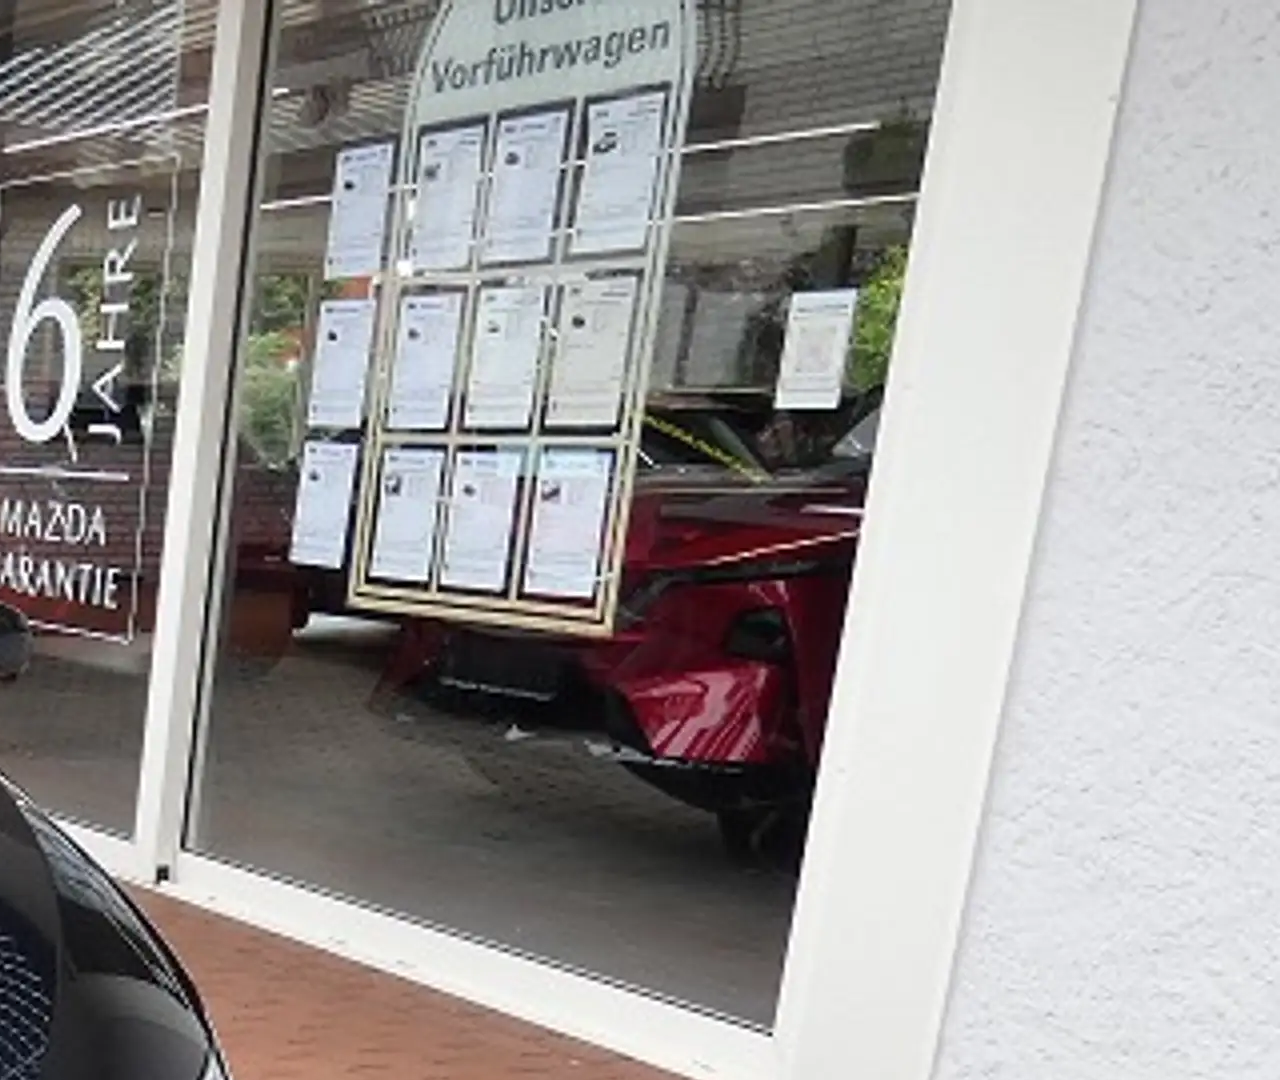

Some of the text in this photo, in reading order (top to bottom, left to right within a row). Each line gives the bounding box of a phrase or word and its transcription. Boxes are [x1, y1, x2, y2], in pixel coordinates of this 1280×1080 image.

[431, 20, 670, 93] Vorführwagen
[6, 203, 82, 443] 6
[88, 194, 141, 445] JAHRE
[0, 498, 106, 546] MAZDA
